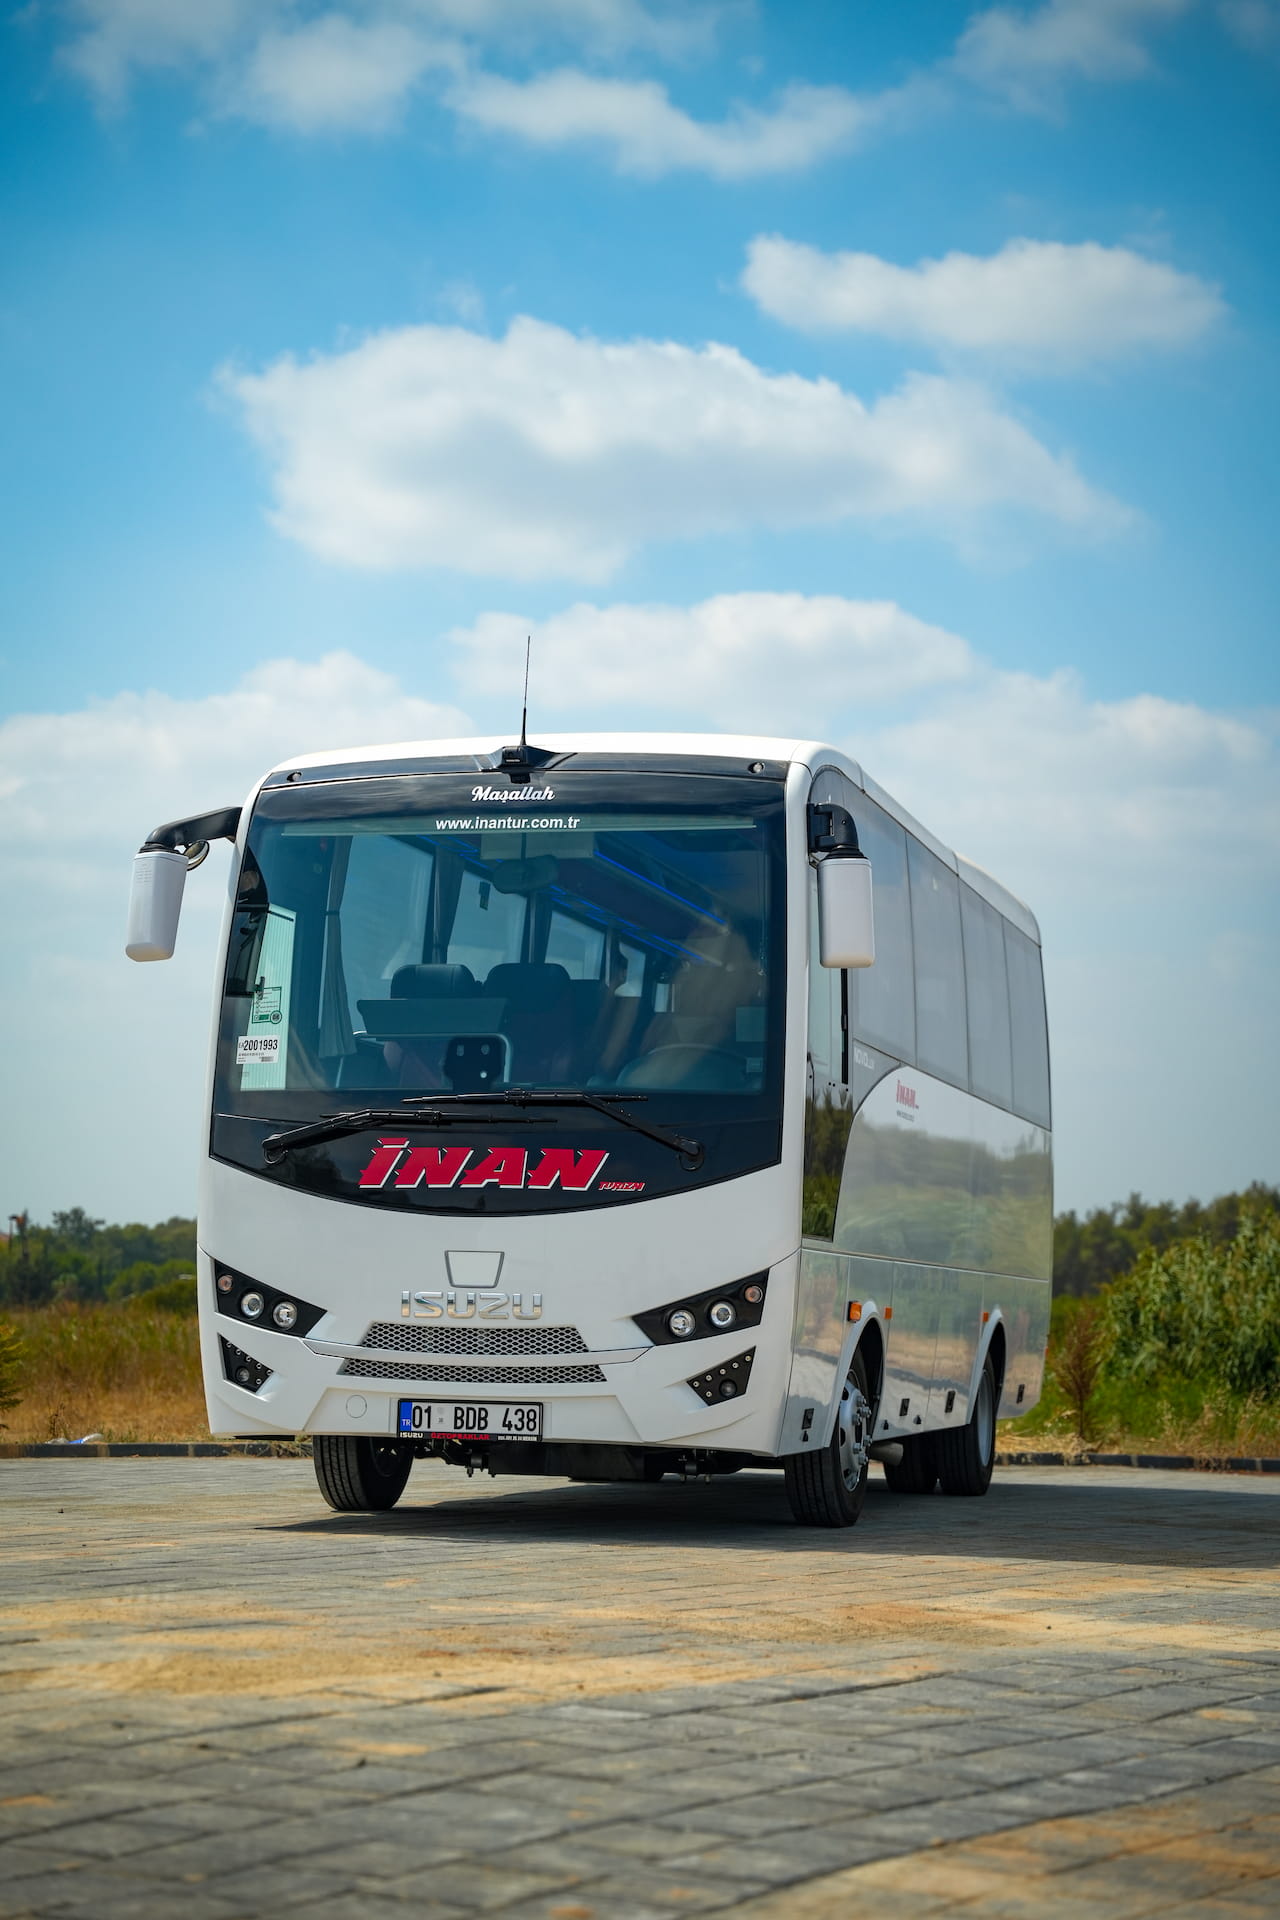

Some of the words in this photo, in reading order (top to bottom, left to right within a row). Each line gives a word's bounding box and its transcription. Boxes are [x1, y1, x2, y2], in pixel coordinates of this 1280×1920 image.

[471, 785, 556, 803] Maşallah
[435, 816, 580, 830] www.inantur.com.tr
[401, 1290, 543, 1320] ISUZU
[402, 1418, 411, 1427] TR
[412, 1405, 432, 1429] 01
[453, 1406, 489, 1431] BDB
[502, 1407, 537, 1432] 438
